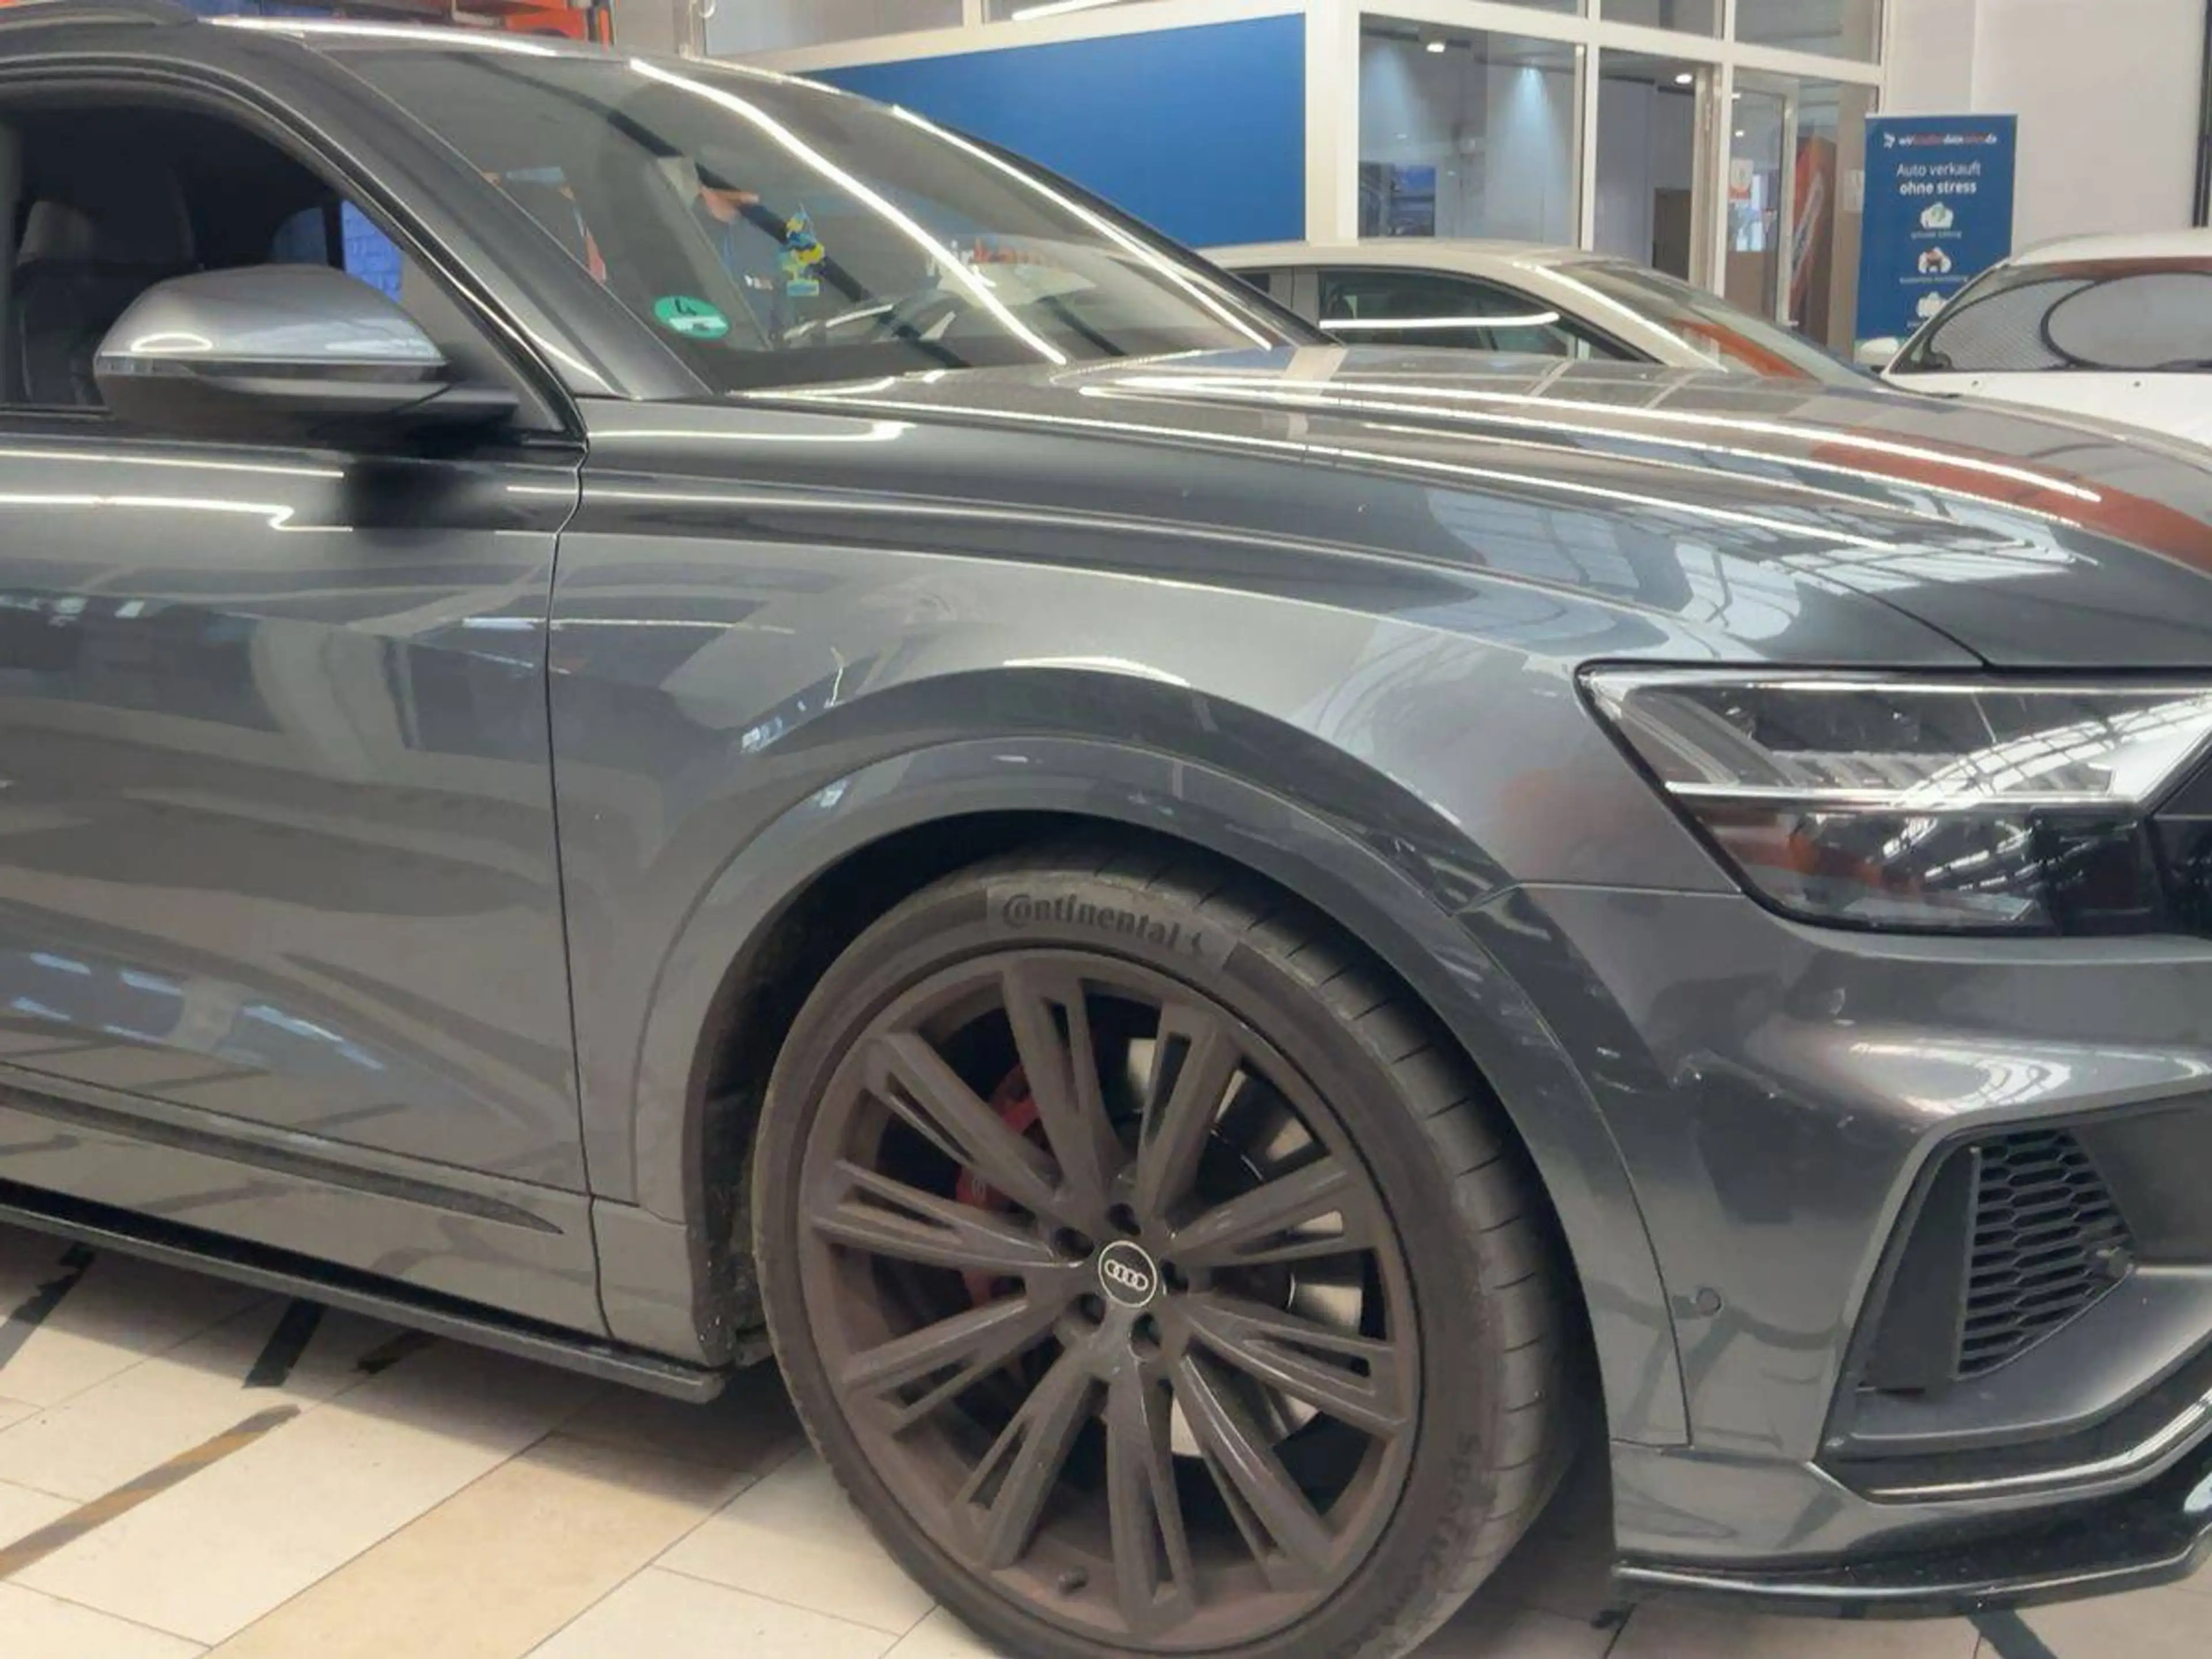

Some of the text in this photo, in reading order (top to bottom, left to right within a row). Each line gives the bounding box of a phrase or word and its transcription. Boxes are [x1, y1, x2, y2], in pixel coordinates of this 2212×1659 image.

[1896, 160, 1980, 177] Auto verkauft
[1900, 180, 1978, 196] ohne stress
[1002, 893, 1180, 950] Continental
